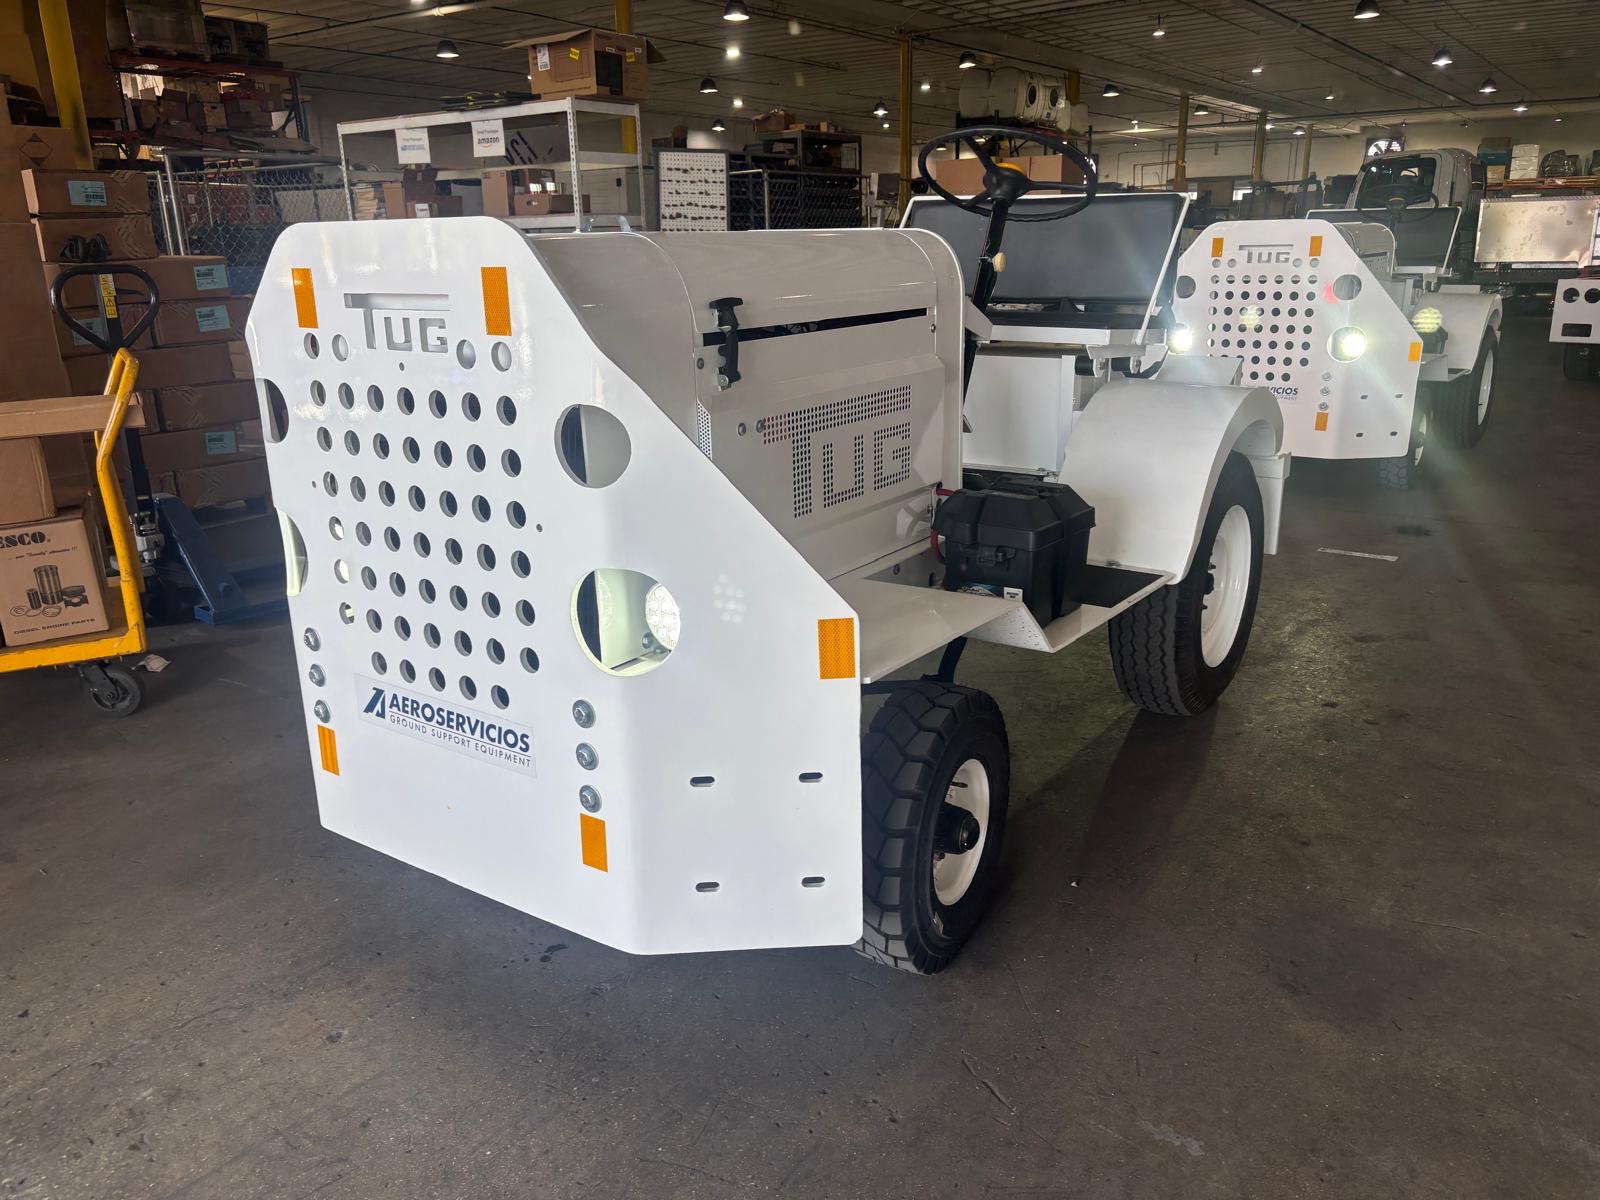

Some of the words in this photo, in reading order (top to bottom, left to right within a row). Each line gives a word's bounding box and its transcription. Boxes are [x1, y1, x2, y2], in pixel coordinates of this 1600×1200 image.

[477, 136, 500, 145] amazon
[1239, 243, 1294, 264] TUG
[343, 292, 450, 354] TUG
[763, 384, 911, 519] TUG
[388, 692, 530, 753] AEROSERVICIOS
[389, 714, 427, 734] GROUND
[431, 728, 471, 749] SUPPORT
[475, 742, 531, 768] EQUIPMENT
